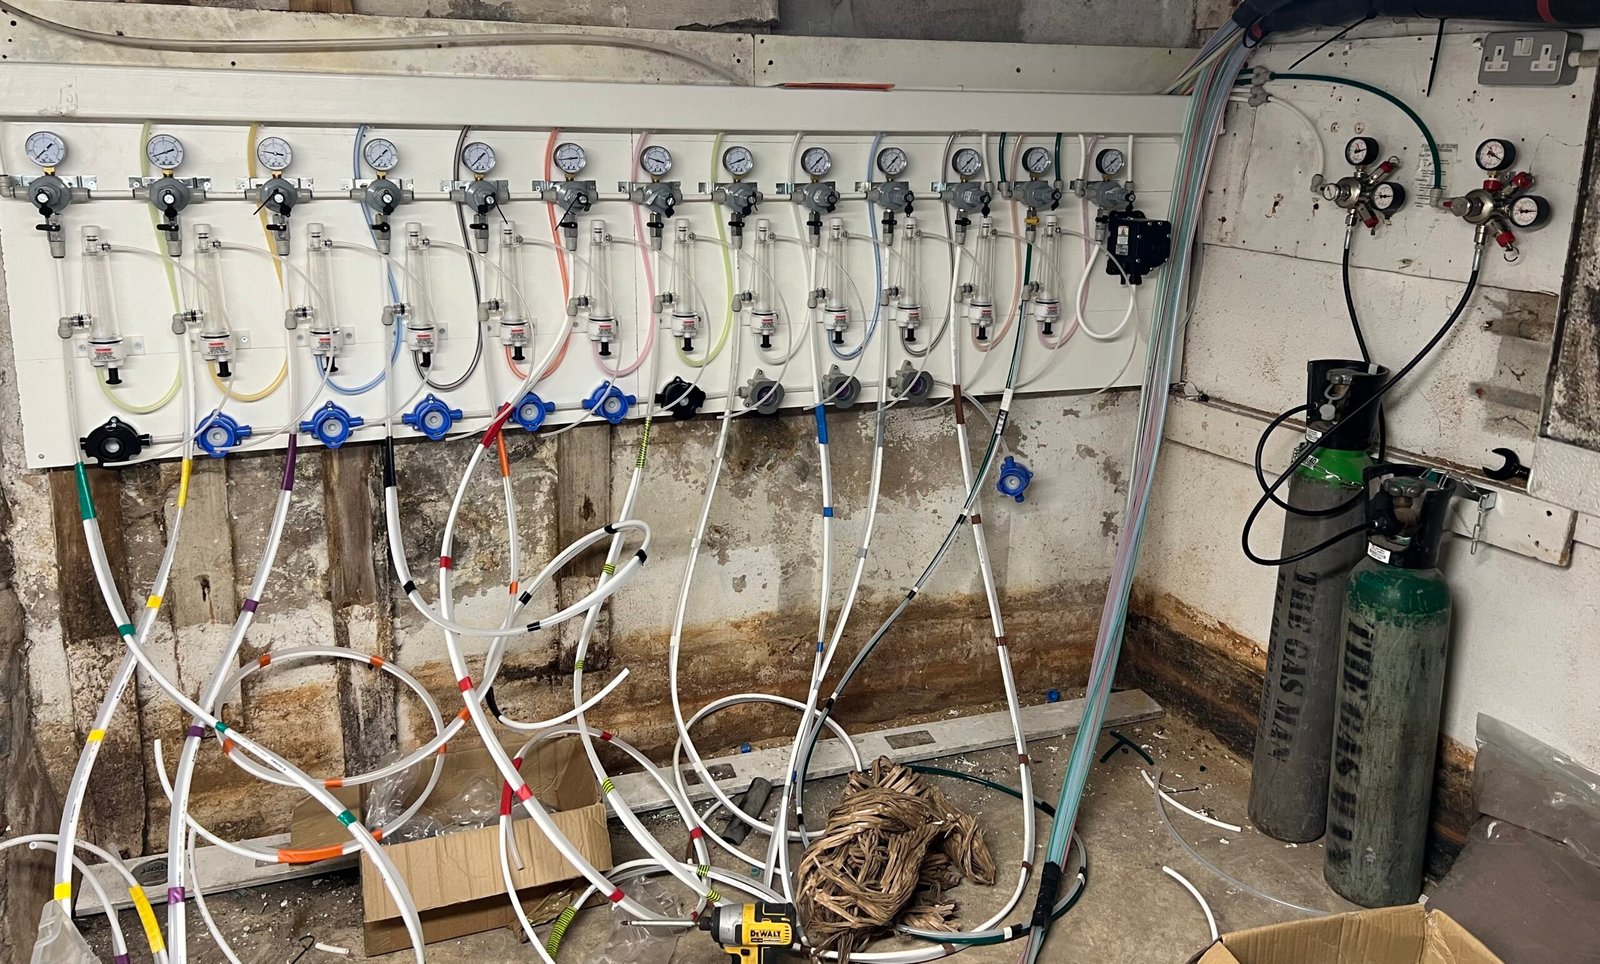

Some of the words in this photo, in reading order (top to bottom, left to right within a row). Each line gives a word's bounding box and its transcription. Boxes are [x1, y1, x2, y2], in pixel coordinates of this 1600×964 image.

[1287, 571, 1318, 634] THE
[1279, 637, 1309, 696] GAS
[1343, 618, 1377, 701] THE
[1268, 698, 1300, 763] MAN
[1335, 701, 1365, 779] GAS
